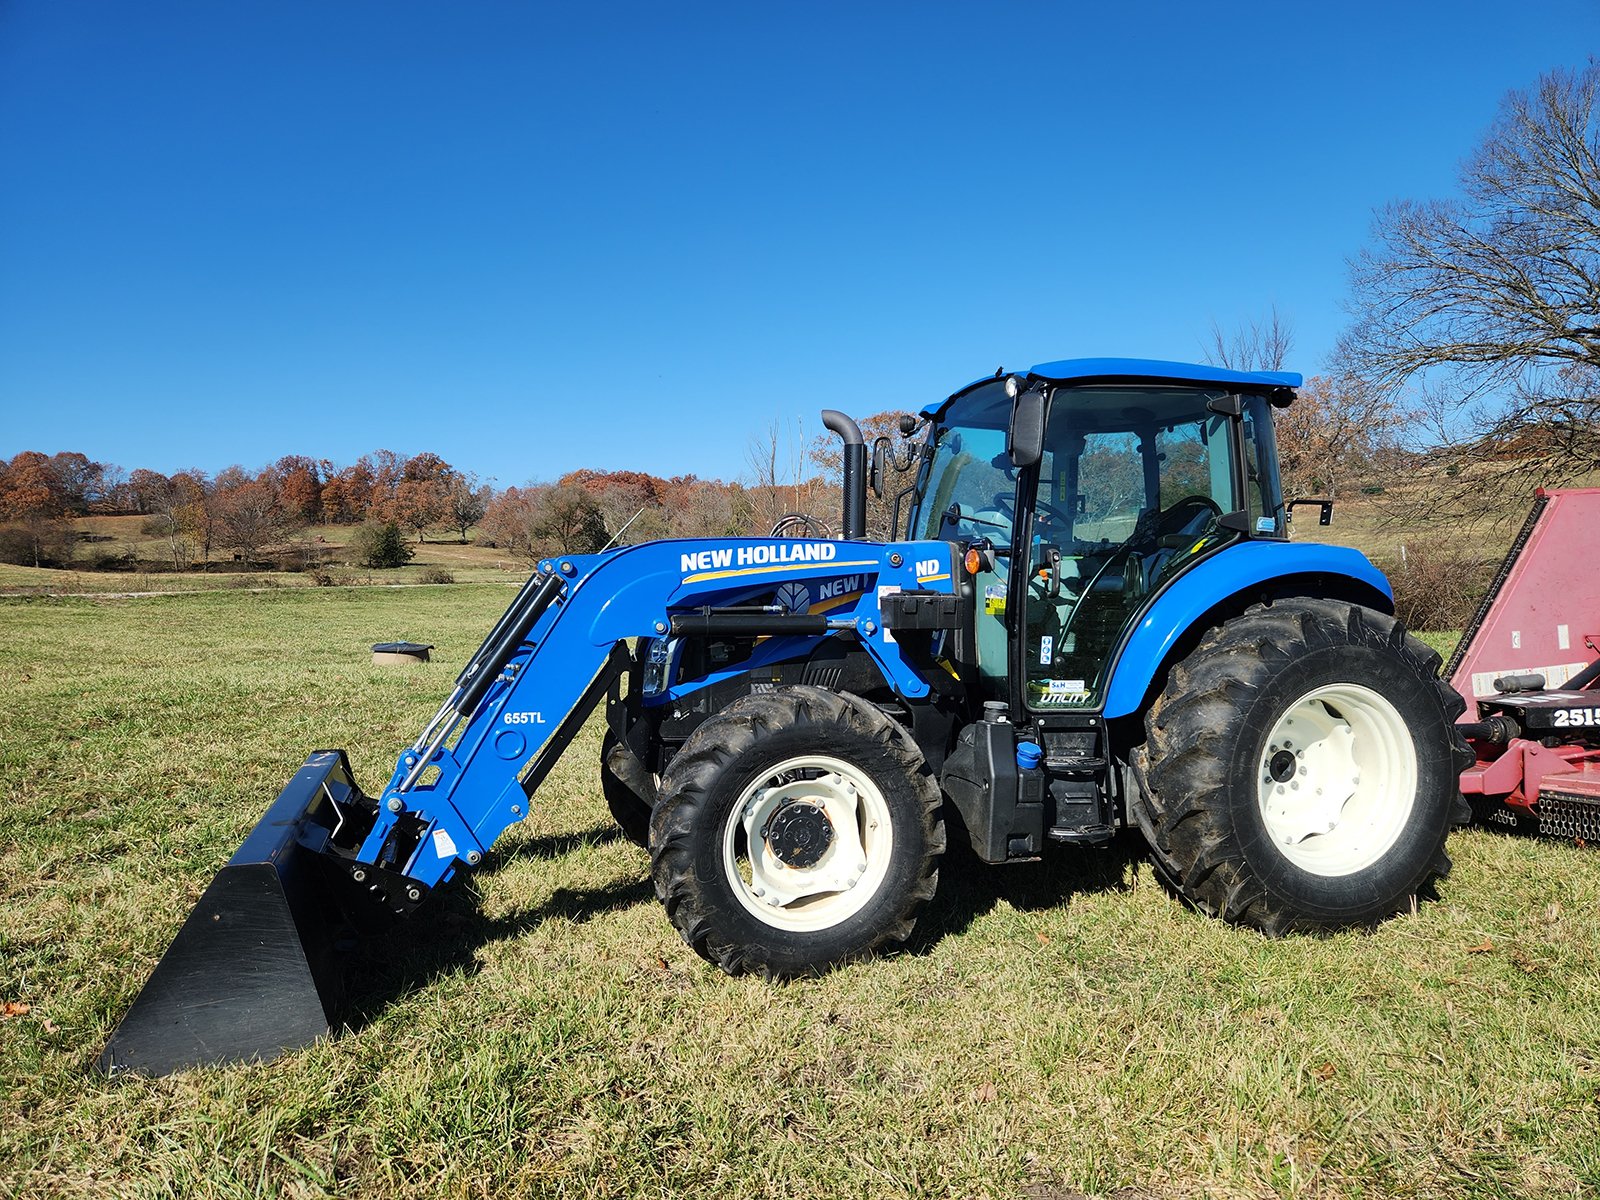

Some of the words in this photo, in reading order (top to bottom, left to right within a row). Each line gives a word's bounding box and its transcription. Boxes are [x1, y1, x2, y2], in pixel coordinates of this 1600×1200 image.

[681, 549, 733, 572] NEW
[737, 543, 836, 566] HOLLAND
[820, 574, 860, 600] NEW
[1040, 692, 1091, 703] UTILITY
[503, 711, 546, 725] 655TL
